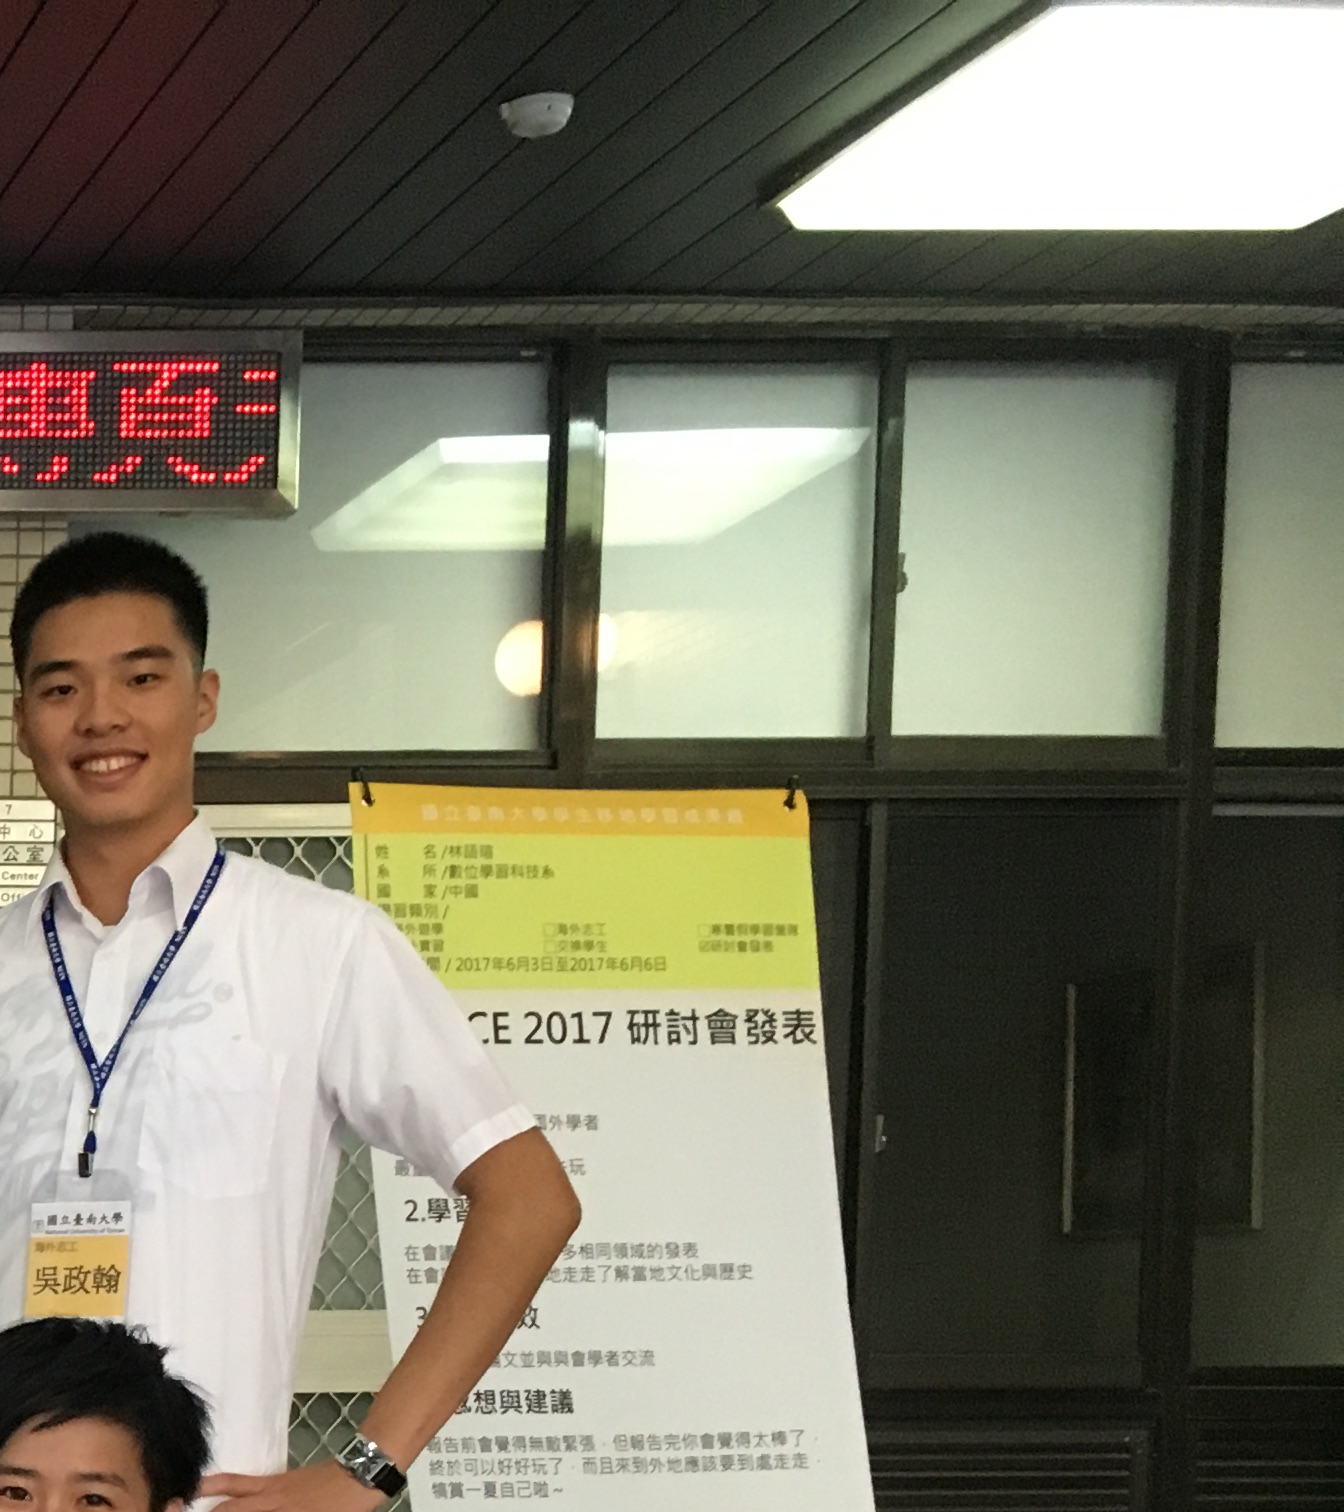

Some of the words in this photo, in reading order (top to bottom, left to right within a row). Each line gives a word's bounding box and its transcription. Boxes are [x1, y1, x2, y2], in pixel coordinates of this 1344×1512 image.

[1, 871, 40, 881] Center
[455, 955, 667, 973] 2017年6月3日至2017年6月6日
[523, 1011, 613, 1045] 2017
[626, 1008, 818, 1047] 研討會發表
[47, 1212, 123, 1227] 國立臺南大學
[32, 1264, 122, 1296] 吳政翰
